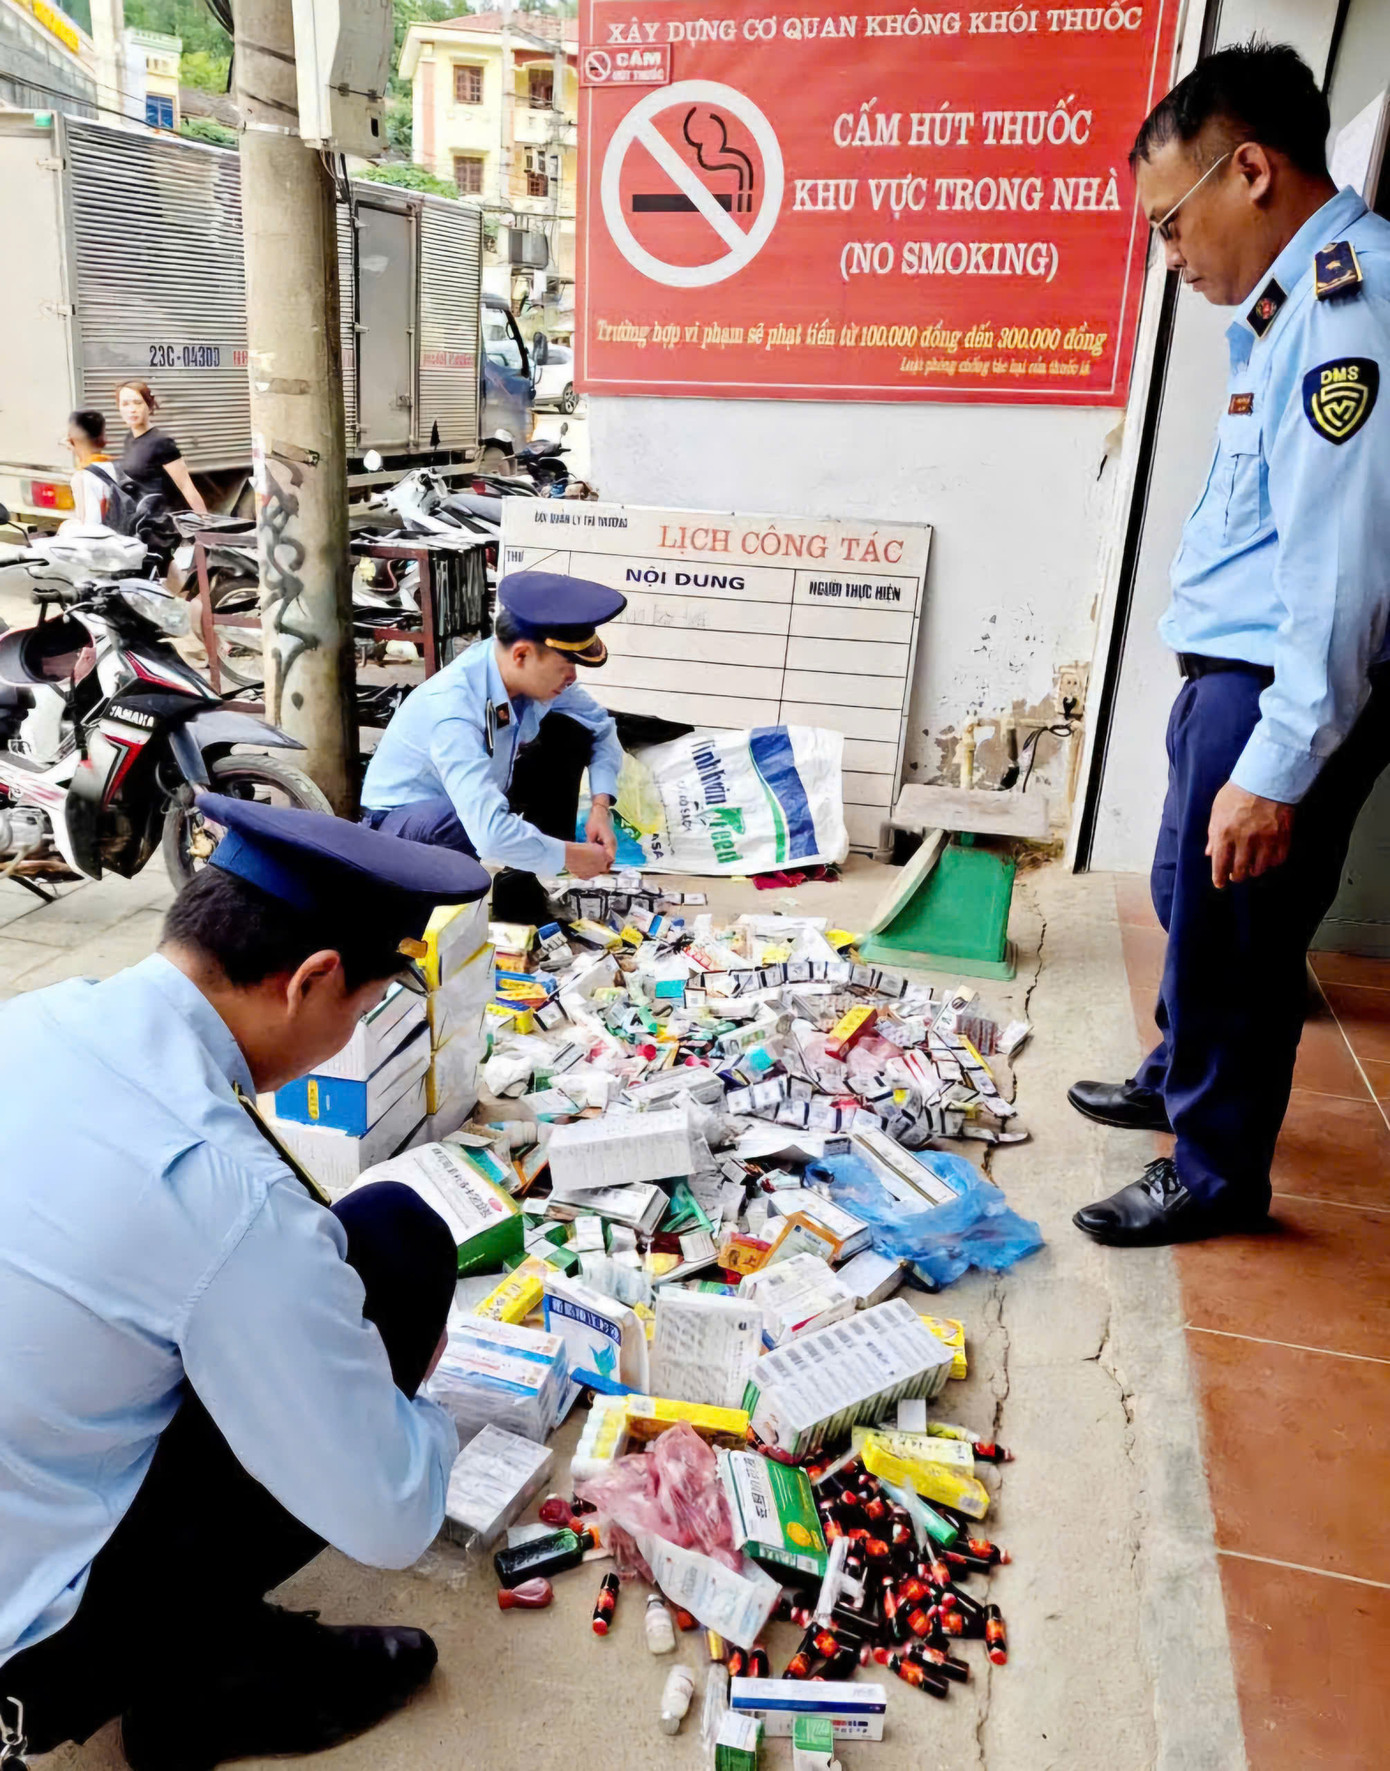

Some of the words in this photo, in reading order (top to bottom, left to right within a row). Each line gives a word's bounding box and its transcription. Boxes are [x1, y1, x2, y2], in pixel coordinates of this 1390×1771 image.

[607, 17, 660, 43] XÂY
[667, 18, 737, 48] DỰNG
[743, 15, 777, 40] CƠ
[782, 16, 857, 40] QUAN
[865, 9, 961, 37] KHÔNG
[968, 4, 1039, 34] KHÓI
[1047, 0, 1143, 32] THUỐC
[833, 97, 902, 147] CẤM
[908, 100, 975, 147] HÚT
[982, 94, 1093, 146] THUỐC
[792, 178, 859, 211] KHU
[868, 173, 927, 219] VỰC
[935, 177, 1044, 212] TRONG
[1050, 167, 1121, 211] NHÀ
[840, 242, 894, 281] (NO
[901, 242, 1060, 283] SMOKING)
[684, 322, 700, 343] vi
[700, 321, 744, 350] phạm
[766, 322, 802, 351] phạt
[860, 325, 918, 348] 100.000
[998, 327, 1061, 350] 300.000
[1320, 365, 1359, 385] DMS
[657, 524, 731, 555] LỊCH
[740, 524, 828, 558] CÔNG
[841, 530, 905, 565] TÁC
[625, 565, 667, 589] NỘI
[674, 573, 745, 591] DUNG
